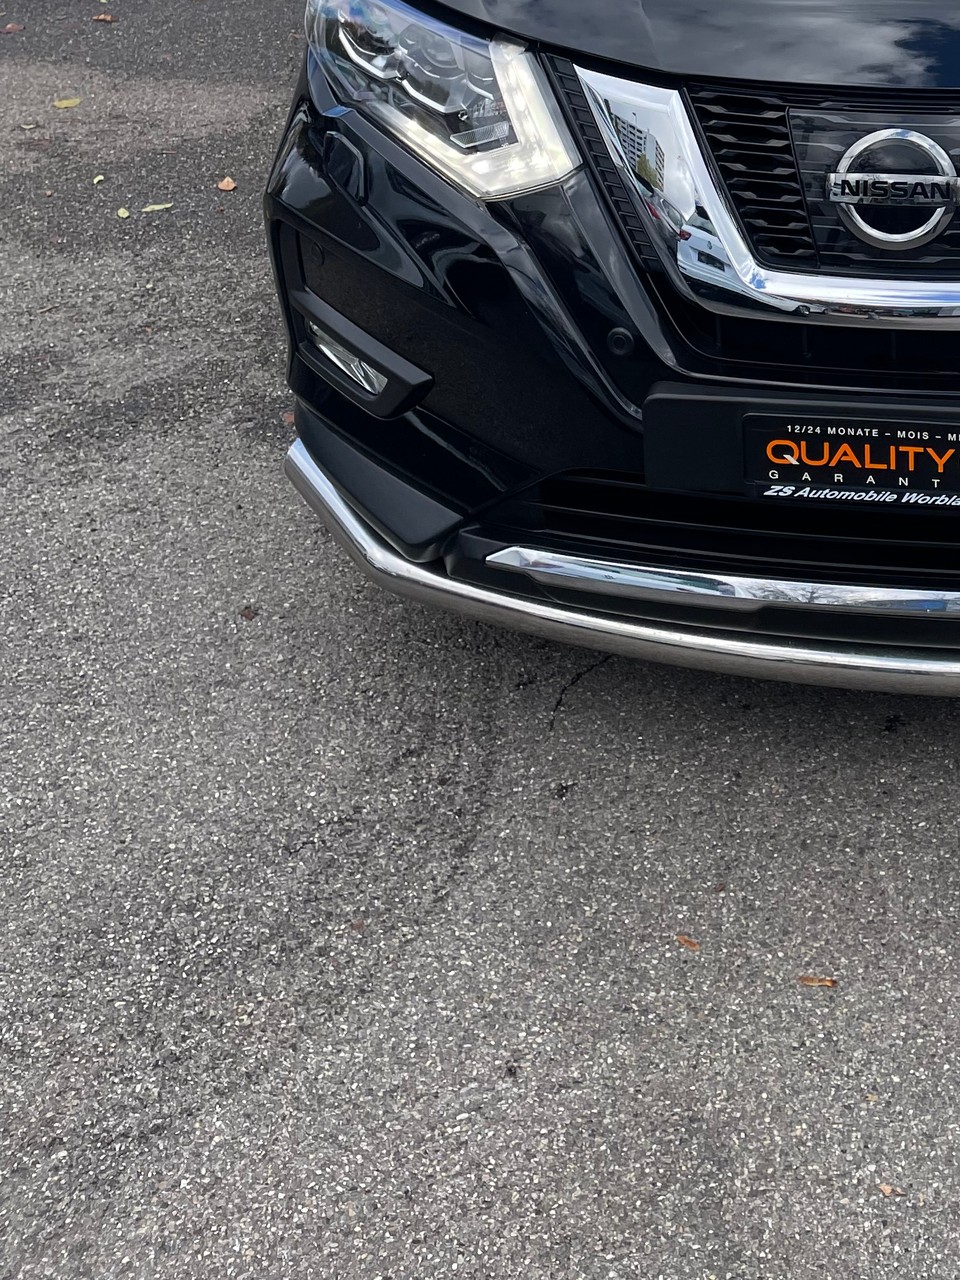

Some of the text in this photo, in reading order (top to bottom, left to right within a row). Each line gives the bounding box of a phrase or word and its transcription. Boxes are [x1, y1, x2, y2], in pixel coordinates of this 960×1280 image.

[840, 179, 950, 200] NISSAN
[786, 425, 822, 434] 12/24
[827, 426, 879, 437] MONATE
[897, 430, 929, 440] MOIS
[766, 439, 955, 473] QUALITY
[763, 485, 796, 497] ZS
[793, 488, 898, 503] Automobile
